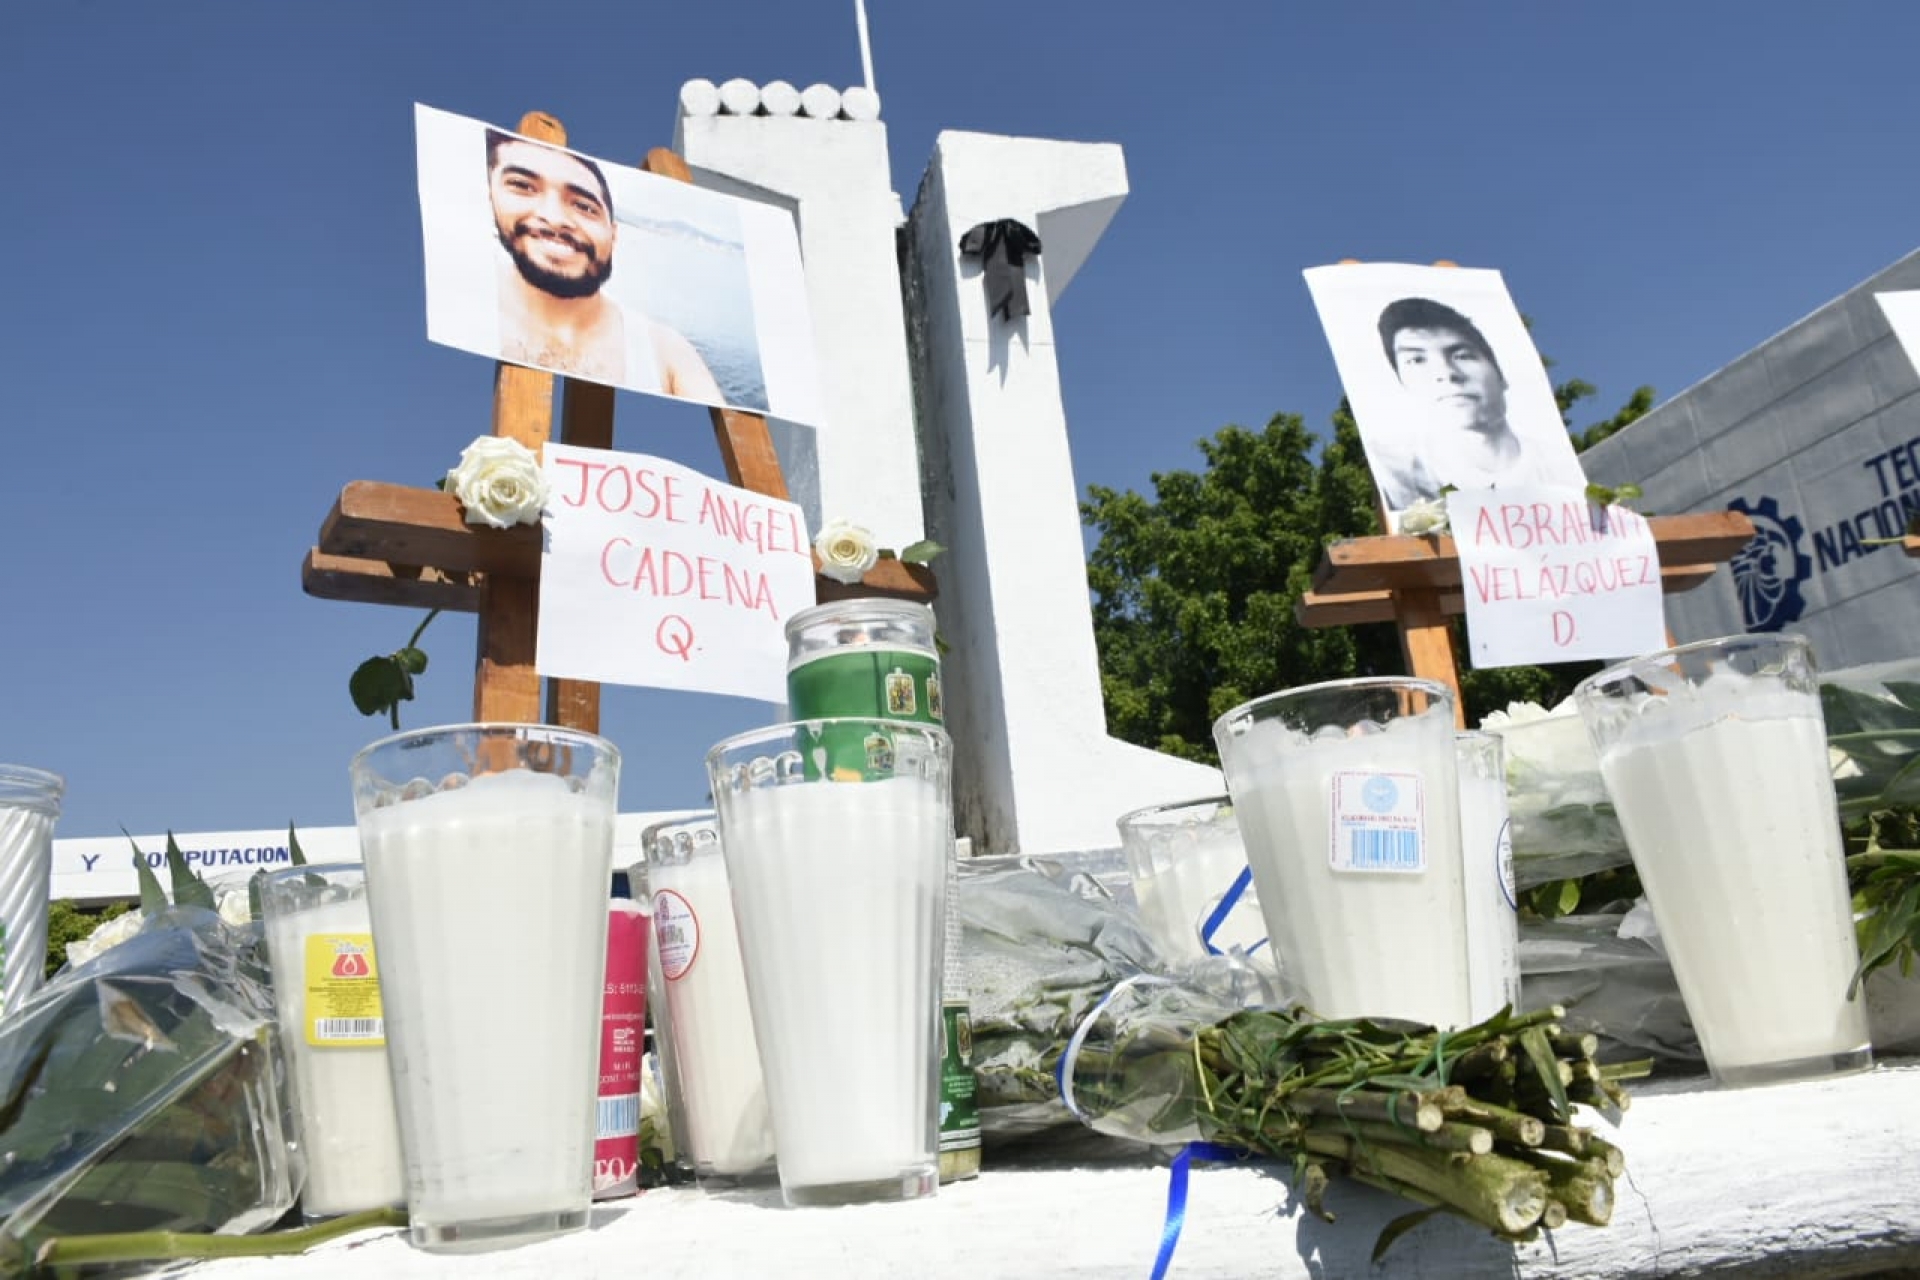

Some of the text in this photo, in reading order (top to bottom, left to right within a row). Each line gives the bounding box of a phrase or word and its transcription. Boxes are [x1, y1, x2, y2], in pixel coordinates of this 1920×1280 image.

[555, 457, 811, 557] JOSE ANGEL
[601, 537, 780, 621] CADENA
[1469, 553, 1657, 605] VELÁZQUEZ
[655, 614, 703, 662] Q.
[81, 847, 289, 872] Y OPUTACION
